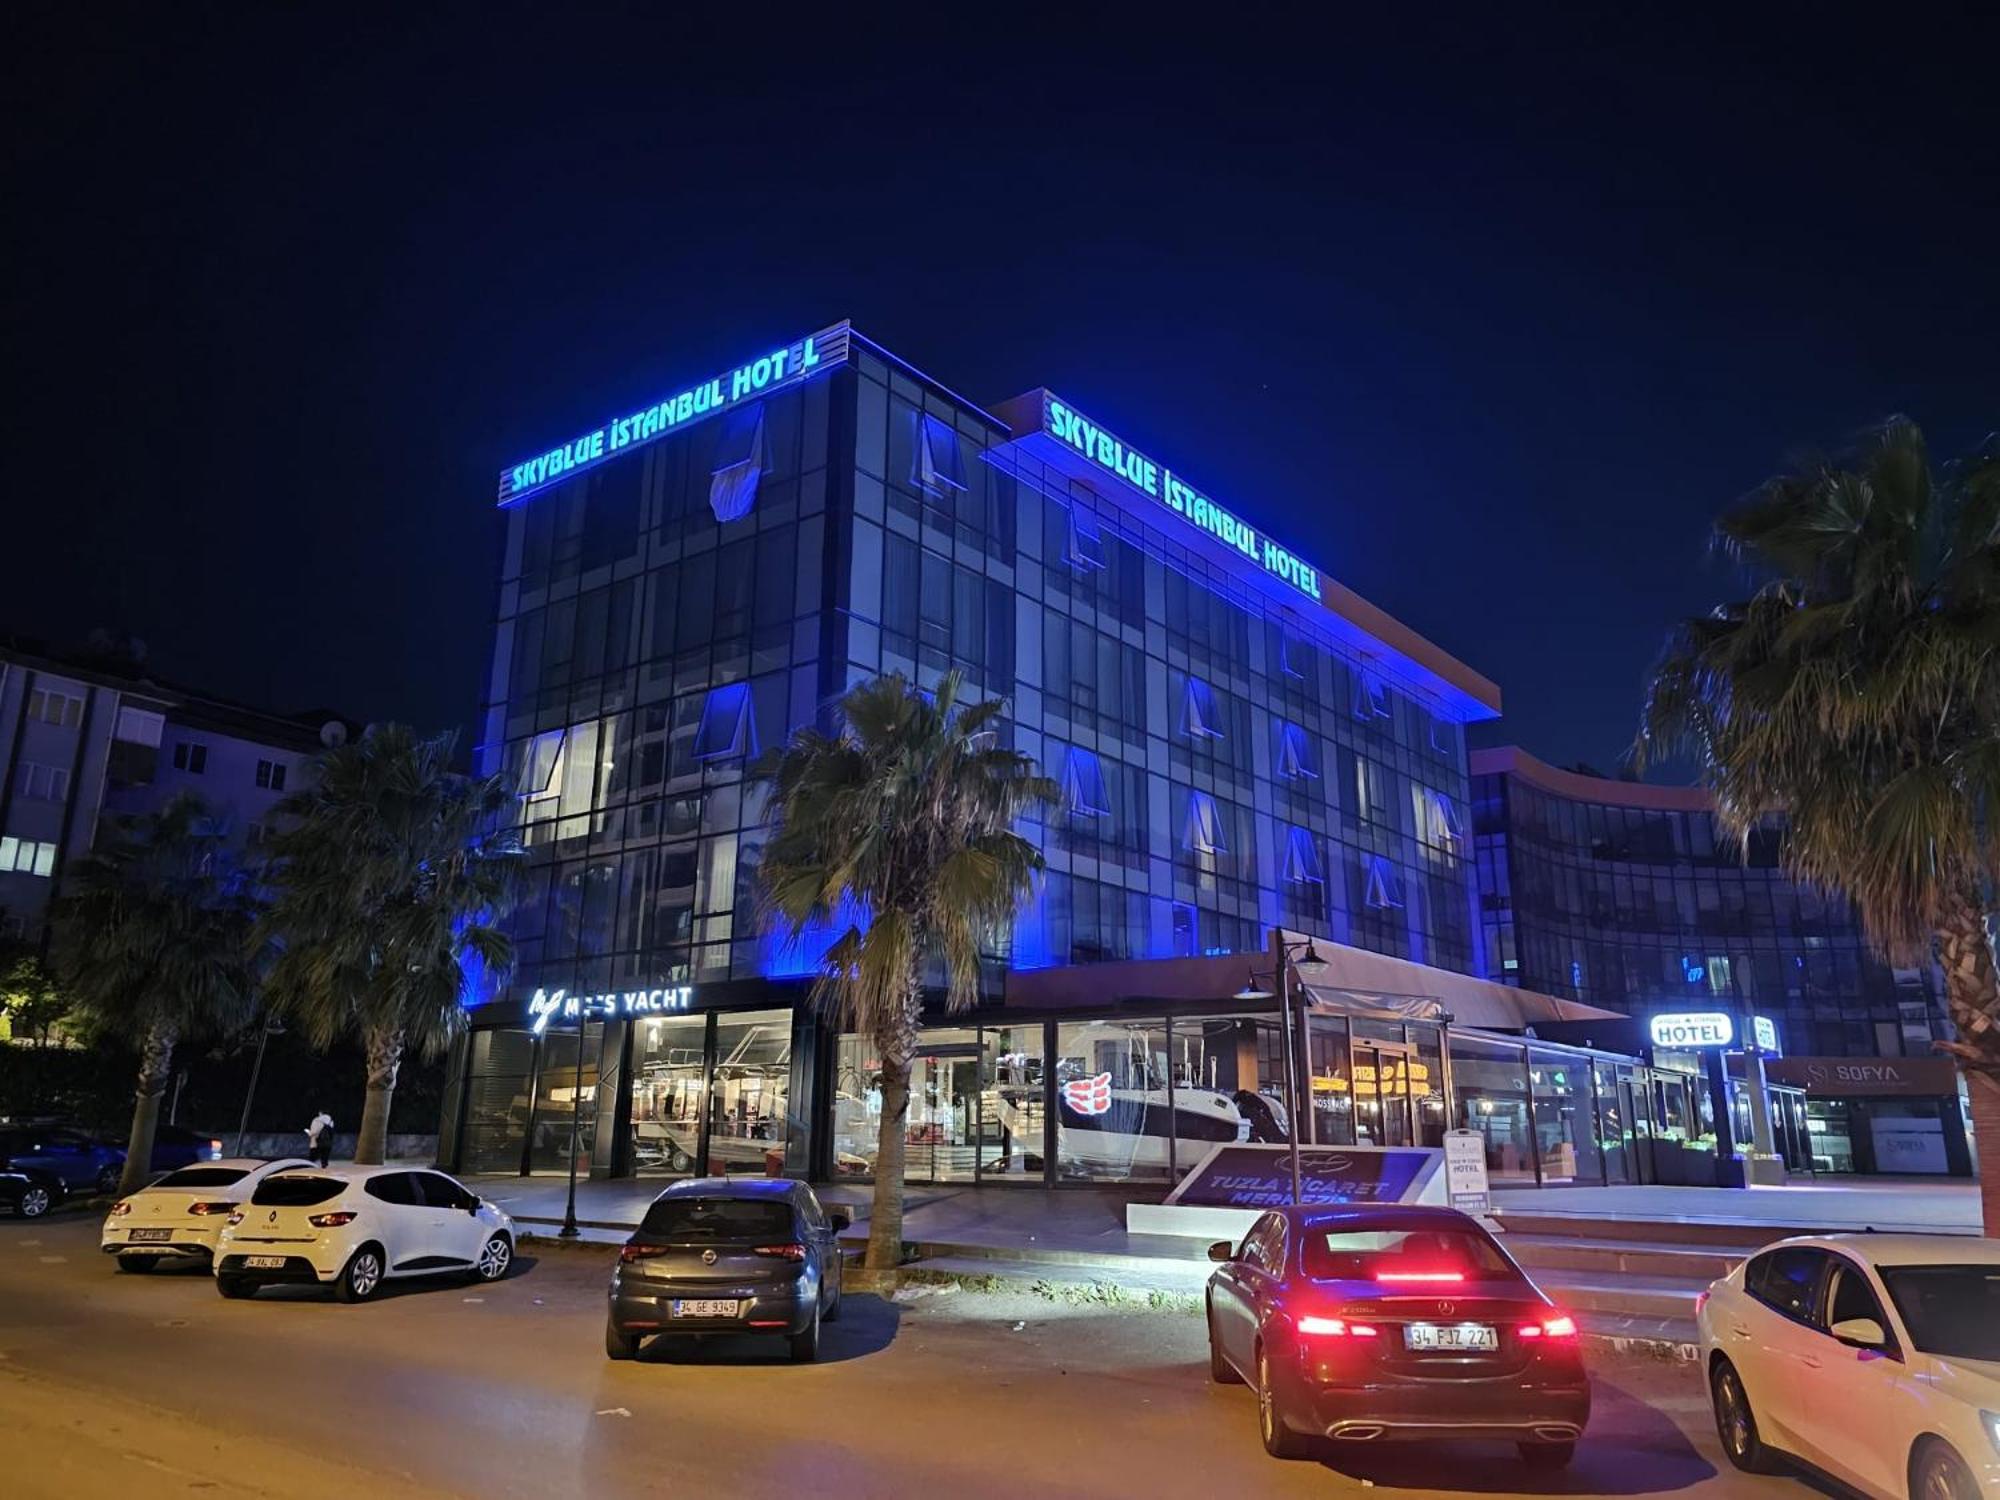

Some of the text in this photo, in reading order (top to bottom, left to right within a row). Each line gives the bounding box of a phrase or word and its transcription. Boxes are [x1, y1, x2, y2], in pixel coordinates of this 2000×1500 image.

[511, 338, 819, 492] SKYBLUE İSTANBUL HOTEL
[1051, 401, 1320, 598] SKYBLUE İSTANBUL HOTEL
[624, 987, 692, 1013] YACHT
[1658, 1025, 1723, 1042] HOTEL
[1836, 1065, 1900, 1081] SOFYA
[1210, 1176, 1279, 1192] TUZLA
[680, 1302, 692, 1312] 34
[1413, 1329, 1493, 1345] 34 FJZ 221
